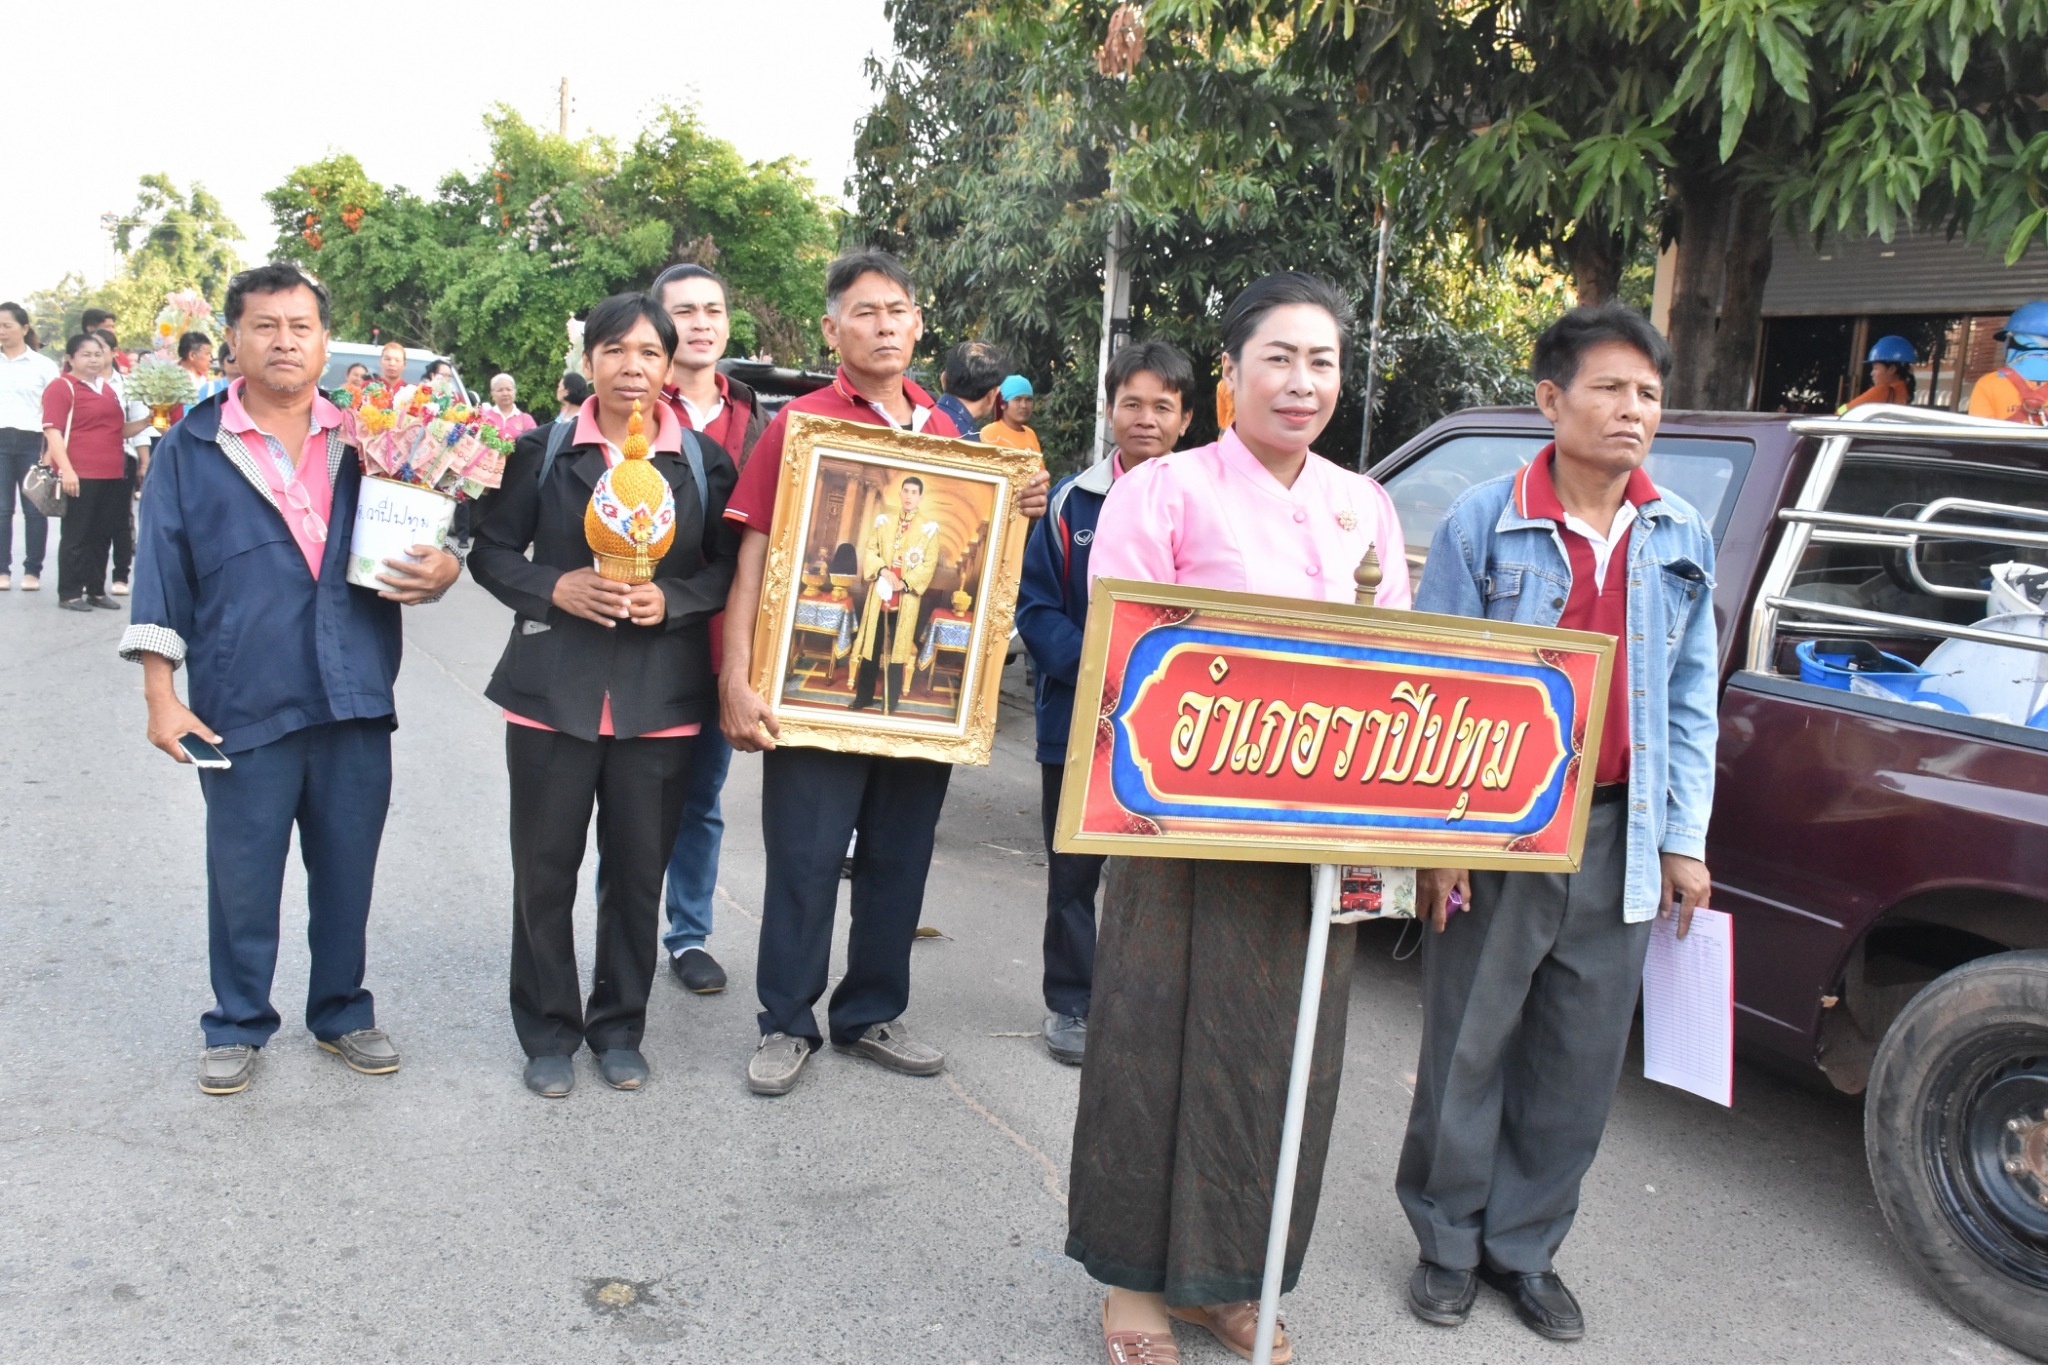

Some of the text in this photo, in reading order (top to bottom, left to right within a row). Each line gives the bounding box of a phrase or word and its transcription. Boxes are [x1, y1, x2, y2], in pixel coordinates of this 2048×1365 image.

[1170, 655, 1530, 824] อำเภอวาปีปทุม
